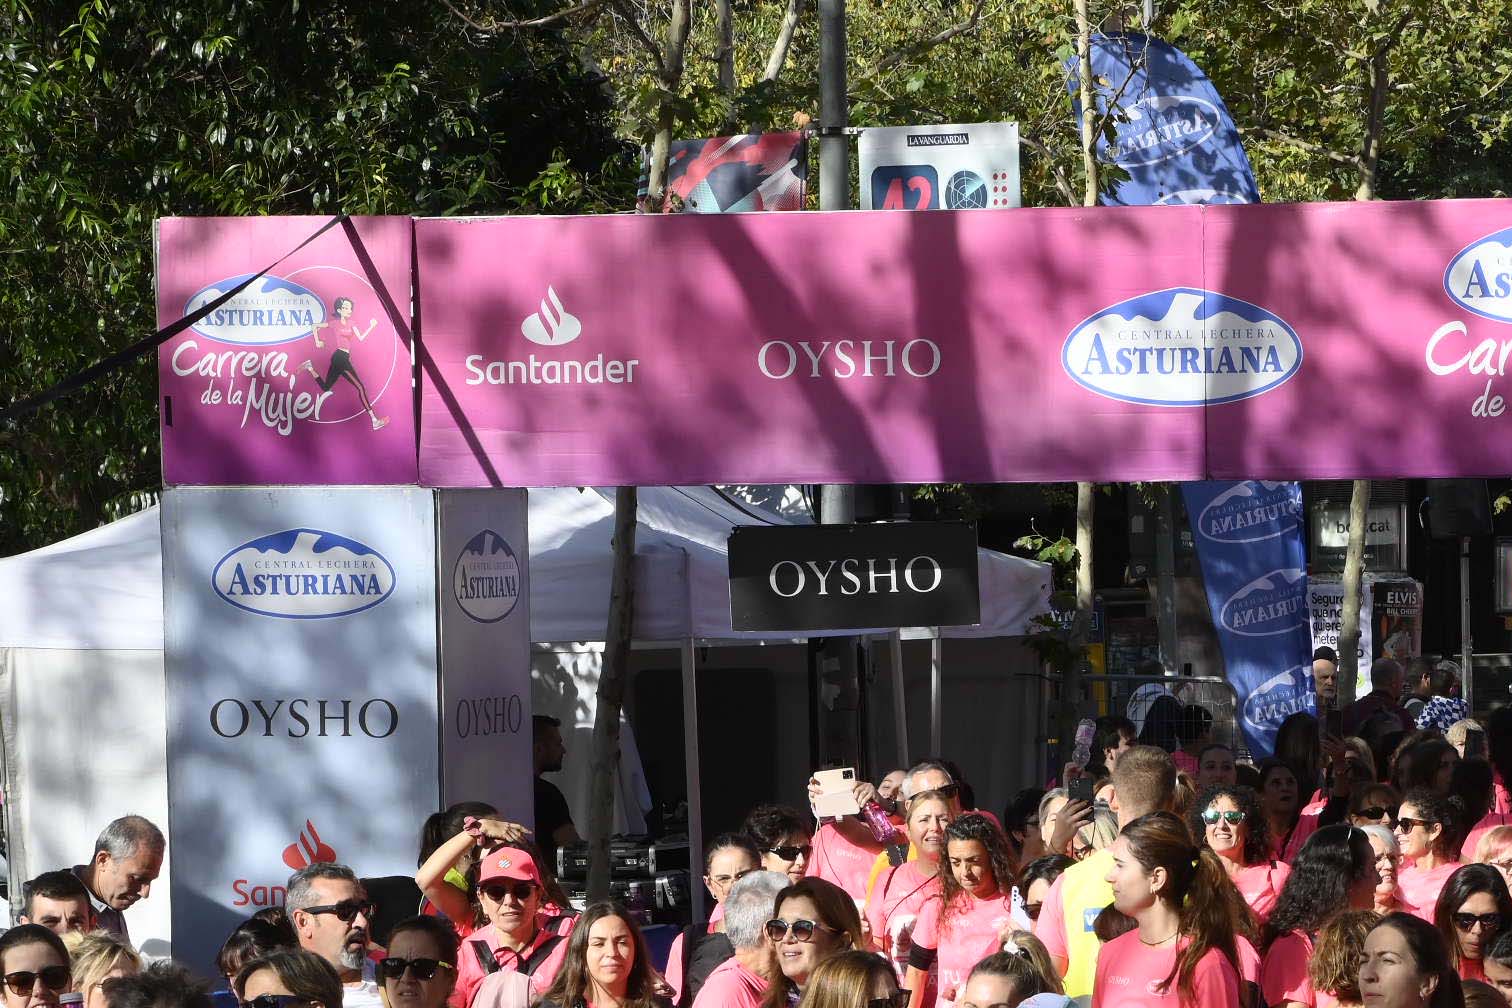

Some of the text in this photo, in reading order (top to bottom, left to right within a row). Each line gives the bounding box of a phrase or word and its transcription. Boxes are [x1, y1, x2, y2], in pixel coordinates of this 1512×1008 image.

[1117, 326, 1276, 342] CENTRAL LECHERA
[171, 339, 290, 378] Carrera
[465, 351, 640, 386] Santander
[757, 337, 943, 381] OYSHO
[1081, 332, 1284, 377] ASTURIANA
[200, 372, 334, 437] de la Mujer
[1471, 378, 1506, 418] de
[226, 561, 384, 597] ASTURIANA
[254, 558, 376, 570] CENTRAL LECHERA
[457, 564, 517, 601] ASTURIANA
[769, 554, 943, 600] OYSHO
[1386, 591, 1417, 604] ELVIS
[209, 697, 400, 739] OYSHO
[456, 693, 523, 740] OYSHO
